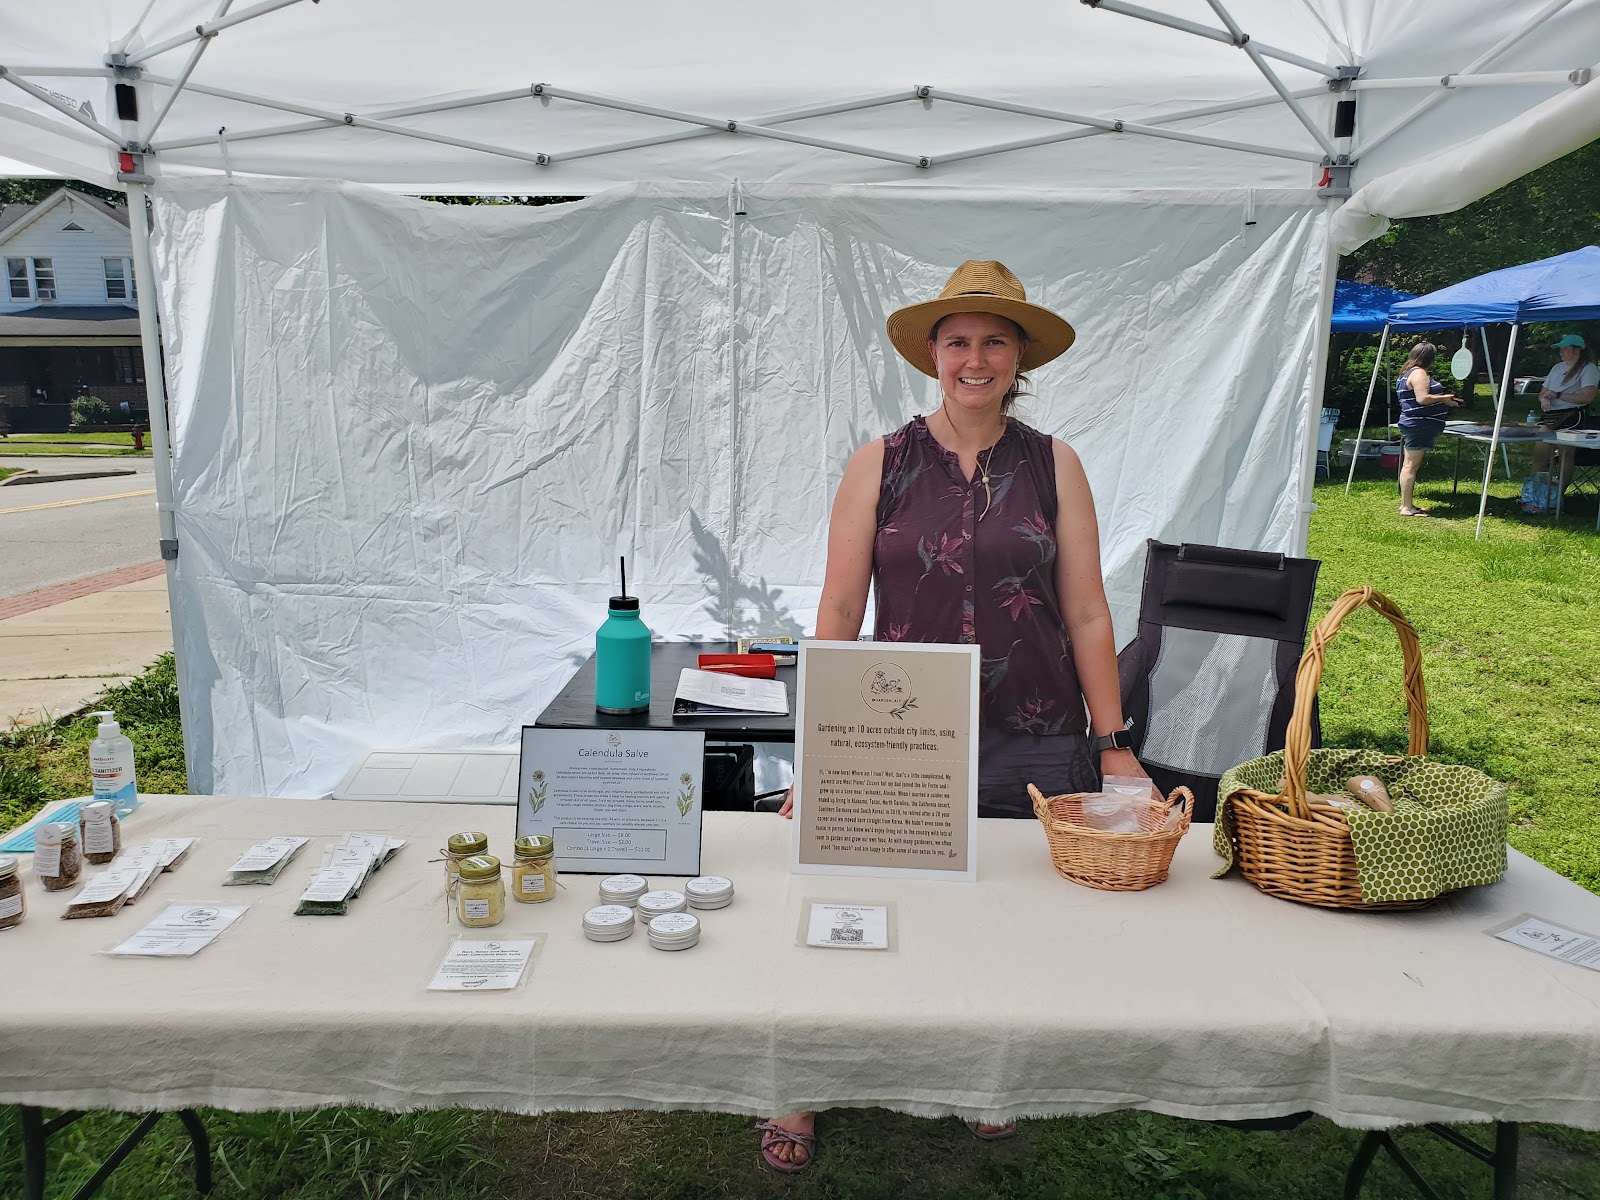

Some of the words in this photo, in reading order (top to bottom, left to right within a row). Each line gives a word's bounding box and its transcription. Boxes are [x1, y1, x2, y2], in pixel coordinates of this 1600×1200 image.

[818, 723, 847, 734] Gardening
[858, 724, 865, 733] 10
[884, 726, 905, 735] outside
[907, 727, 917, 737] city
[920, 728, 937, 737] limits,
[940, 730, 955, 739] using
[831, 739, 852, 748] natural,
[855, 739, 908, 751] ecosystem-friendly
[910, 741, 938, 752] practices.
[578, 748, 623, 758] Calendula
[625, 749, 649, 758] Salve
